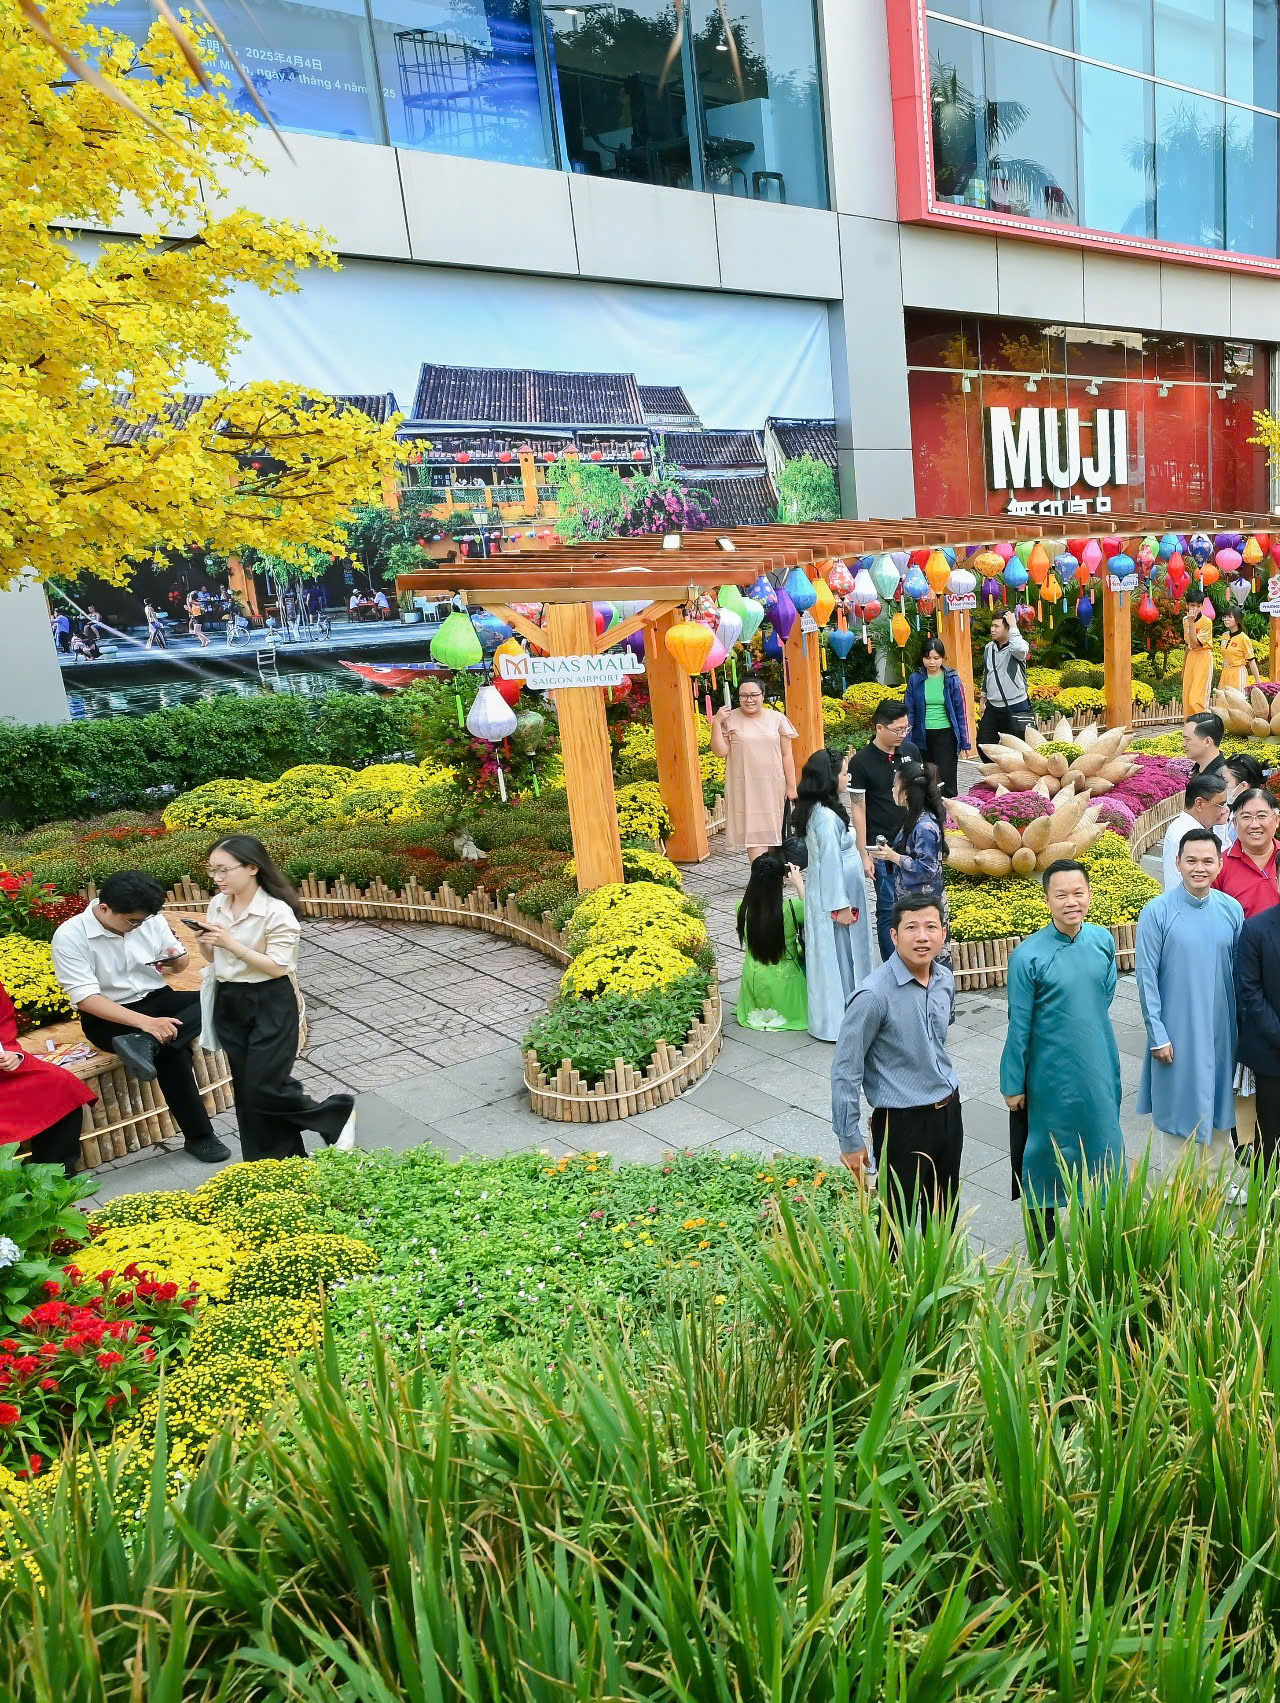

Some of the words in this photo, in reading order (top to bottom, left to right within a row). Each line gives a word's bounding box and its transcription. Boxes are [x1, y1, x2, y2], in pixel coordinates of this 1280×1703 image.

[220, 59, 253, 76] Mih,
[256, 66, 286, 82] ngày
[288, 71, 296, 82] 4
[299, 73, 331, 91] tháng
[334, 79, 342, 90] 4
[344, 81, 368, 95] năm
[382, 87, 396, 99] 25
[989, 406, 1128, 489] MUJI
[505, 656, 582, 676] MENAS
[586, 656, 642, 672] MALL
[532, 676, 573, 686] SAIGON
[575, 674, 619, 684] AIRPORT
